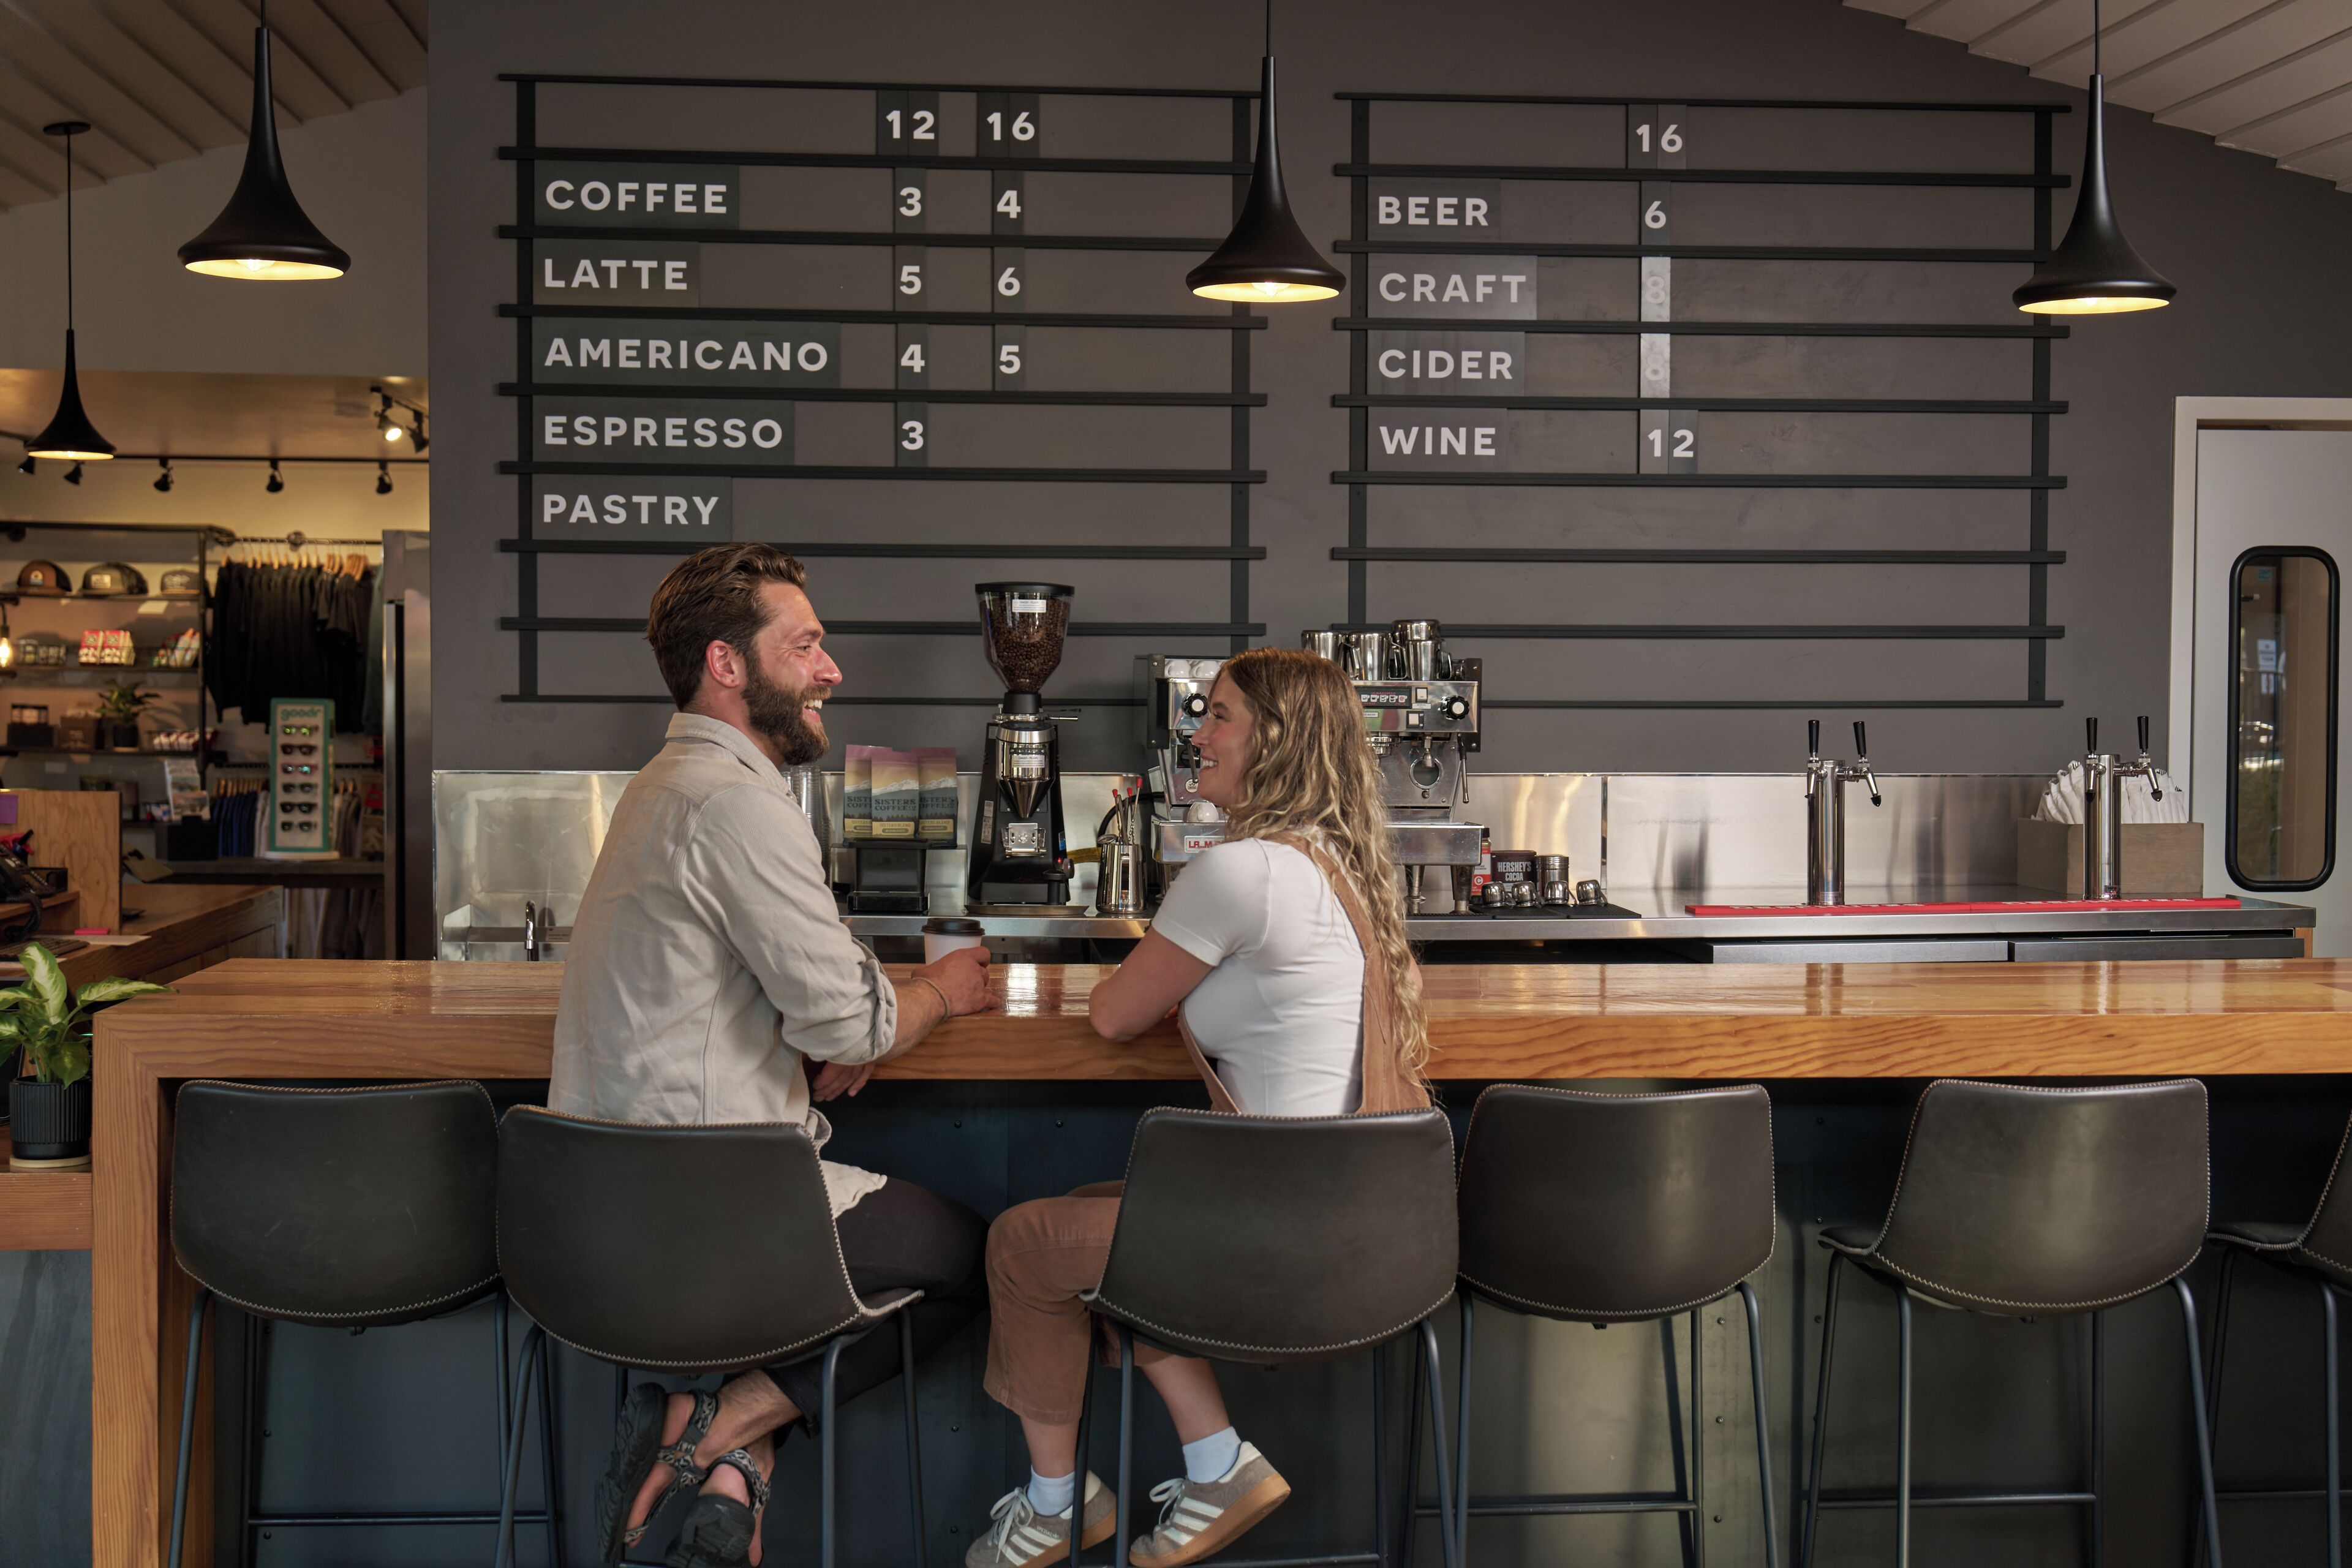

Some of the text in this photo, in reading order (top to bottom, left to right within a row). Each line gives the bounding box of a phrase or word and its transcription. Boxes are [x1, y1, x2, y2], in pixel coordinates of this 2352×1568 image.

[886, 110, 1035, 141] 12 16
[1636, 124, 1683, 153] 16
[546, 180, 1021, 219] COFFEE 3 4
[1379, 196, 1667, 229] BEER 6
[545, 258, 1020, 296] LATTE 5 6
[1379, 273, 1666, 304] CRAFT 8
[545, 337, 1020, 374] AMERICANO 4 5
[1379, 349, 1666, 381] CIDER 8
[545, 416, 924, 450] ESPRESSO 3
[1379, 426, 1694, 458] WINE 12
[543, 494, 718, 525] PASTRY
[1498, 861, 1531, 872] HERSHEY'S
[1505, 872, 1524, 881] COCOA
